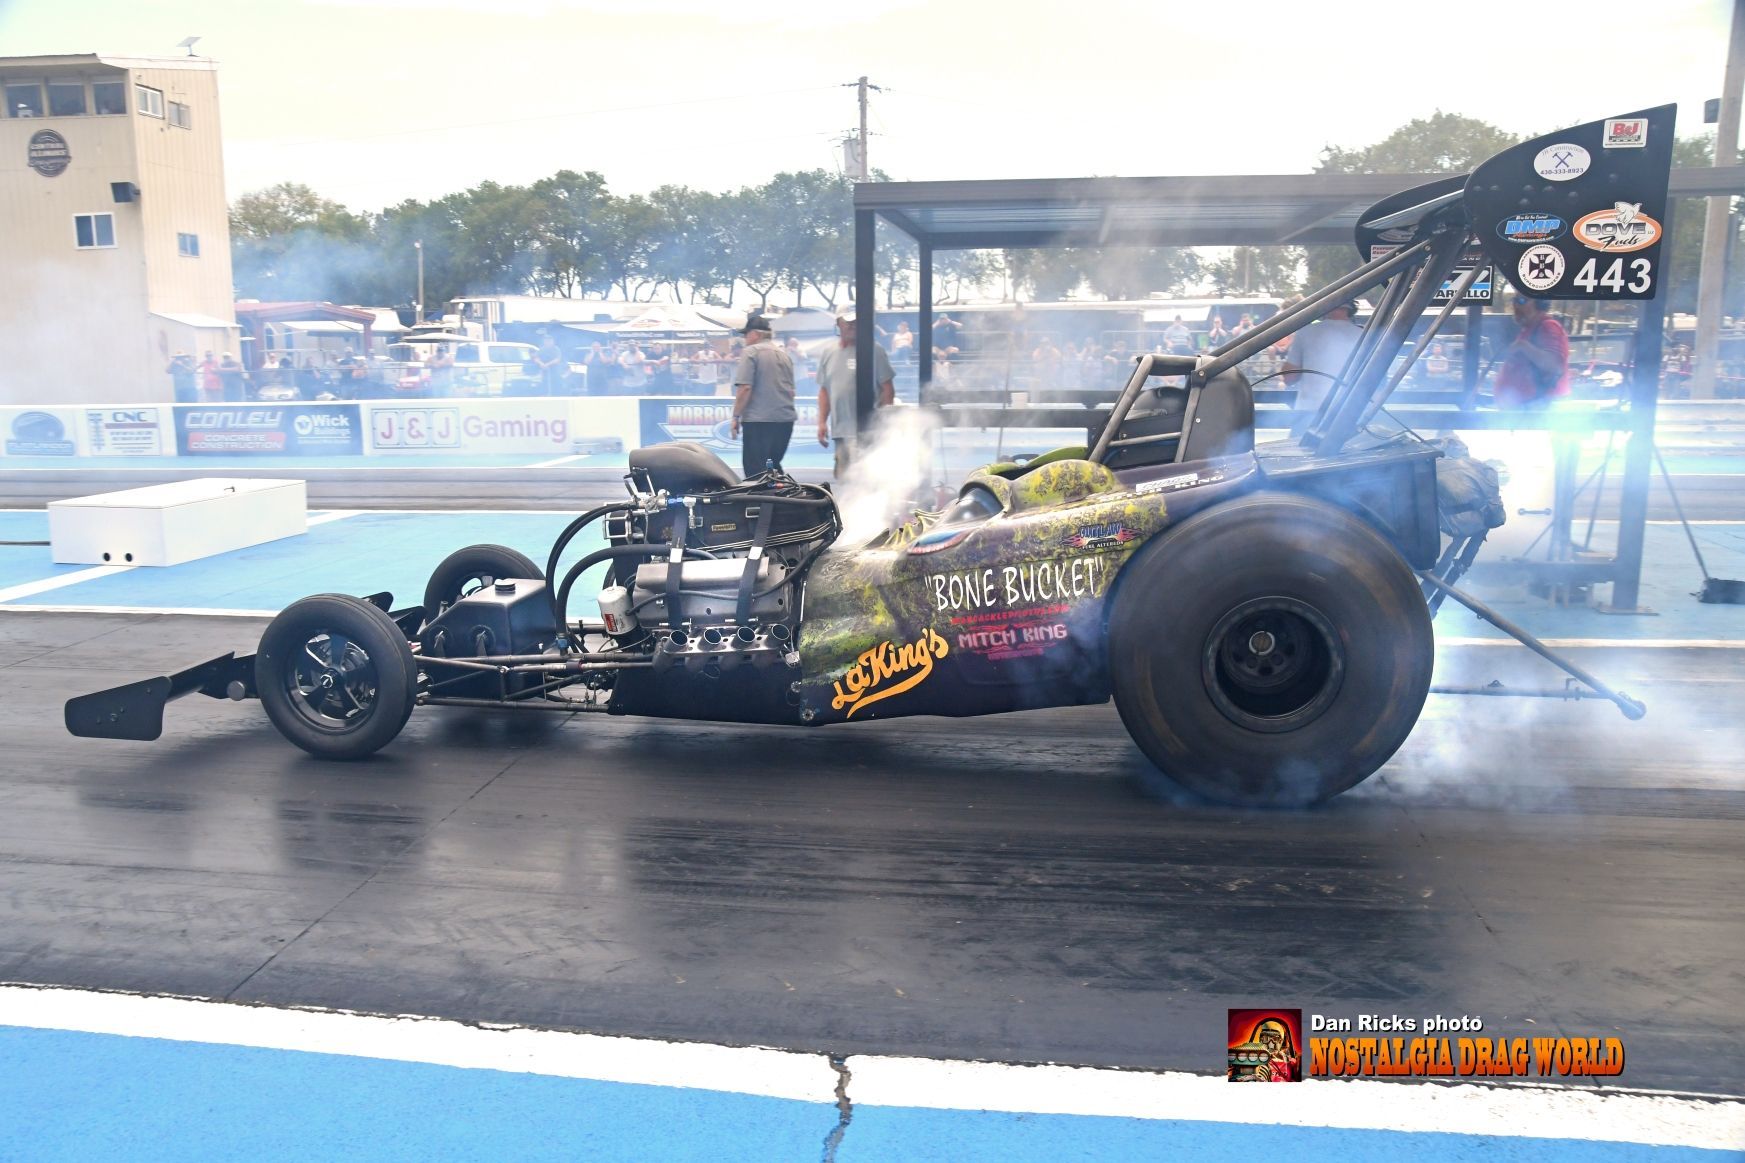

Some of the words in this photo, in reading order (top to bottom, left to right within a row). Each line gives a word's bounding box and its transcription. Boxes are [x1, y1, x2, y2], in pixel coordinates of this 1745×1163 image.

[1613, 122, 1640, 135] B&J
[1505, 219, 1560, 234] DMP
[1586, 222, 1646, 235] DOVE
[1598, 235, 1640, 249] Fuels
[1573, 258, 1651, 294] 443
[112, 411, 148, 422] CNC
[185, 411, 284, 429] CONLEY
[312, 414, 350, 427] Wick
[381, 417, 393, 439] J
[407, 417, 424, 439] &
[438, 417, 450, 439] J
[463, 414, 567, 443] Gaming
[204, 434, 266, 442] CONCRETE
[958, 630, 1015, 648] MITCH
[1022, 624, 1067, 642] KING
